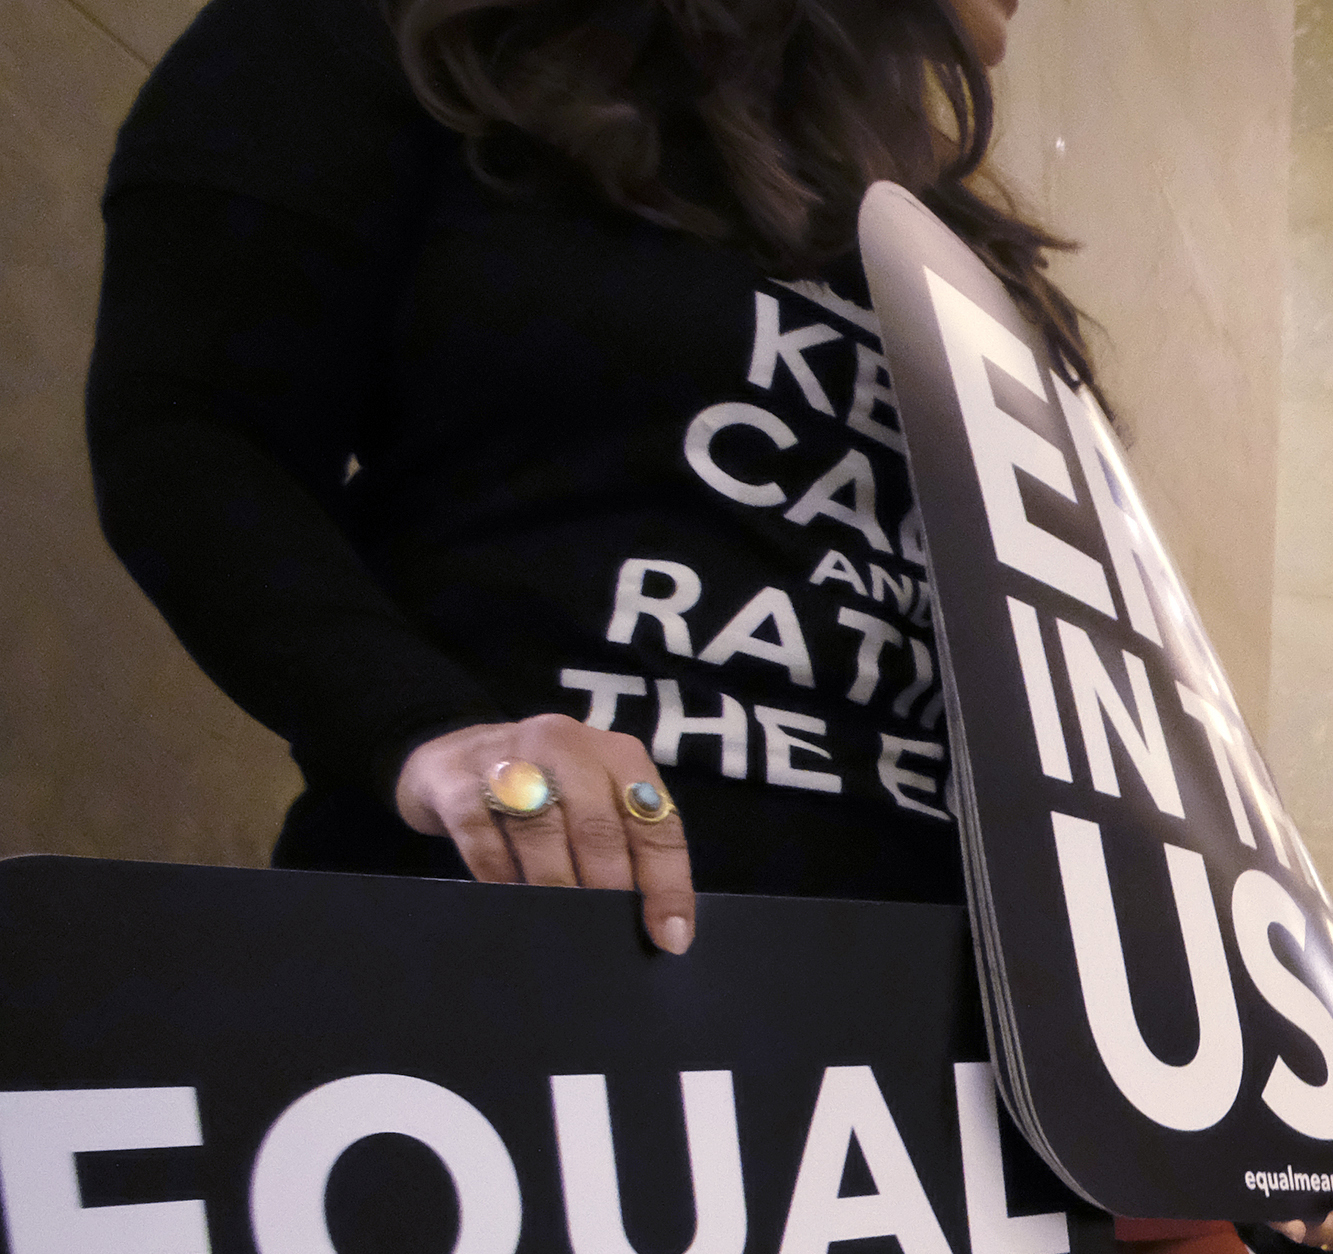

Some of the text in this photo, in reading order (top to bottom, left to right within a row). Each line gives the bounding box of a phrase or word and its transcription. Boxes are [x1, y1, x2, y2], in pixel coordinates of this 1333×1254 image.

[747, 291, 908, 456] KE
[684, 402, 926, 566] CA
[606, 558, 944, 730] RATI
[1006, 594, 1186, 819] IN
[560, 668, 841, 793] THE
